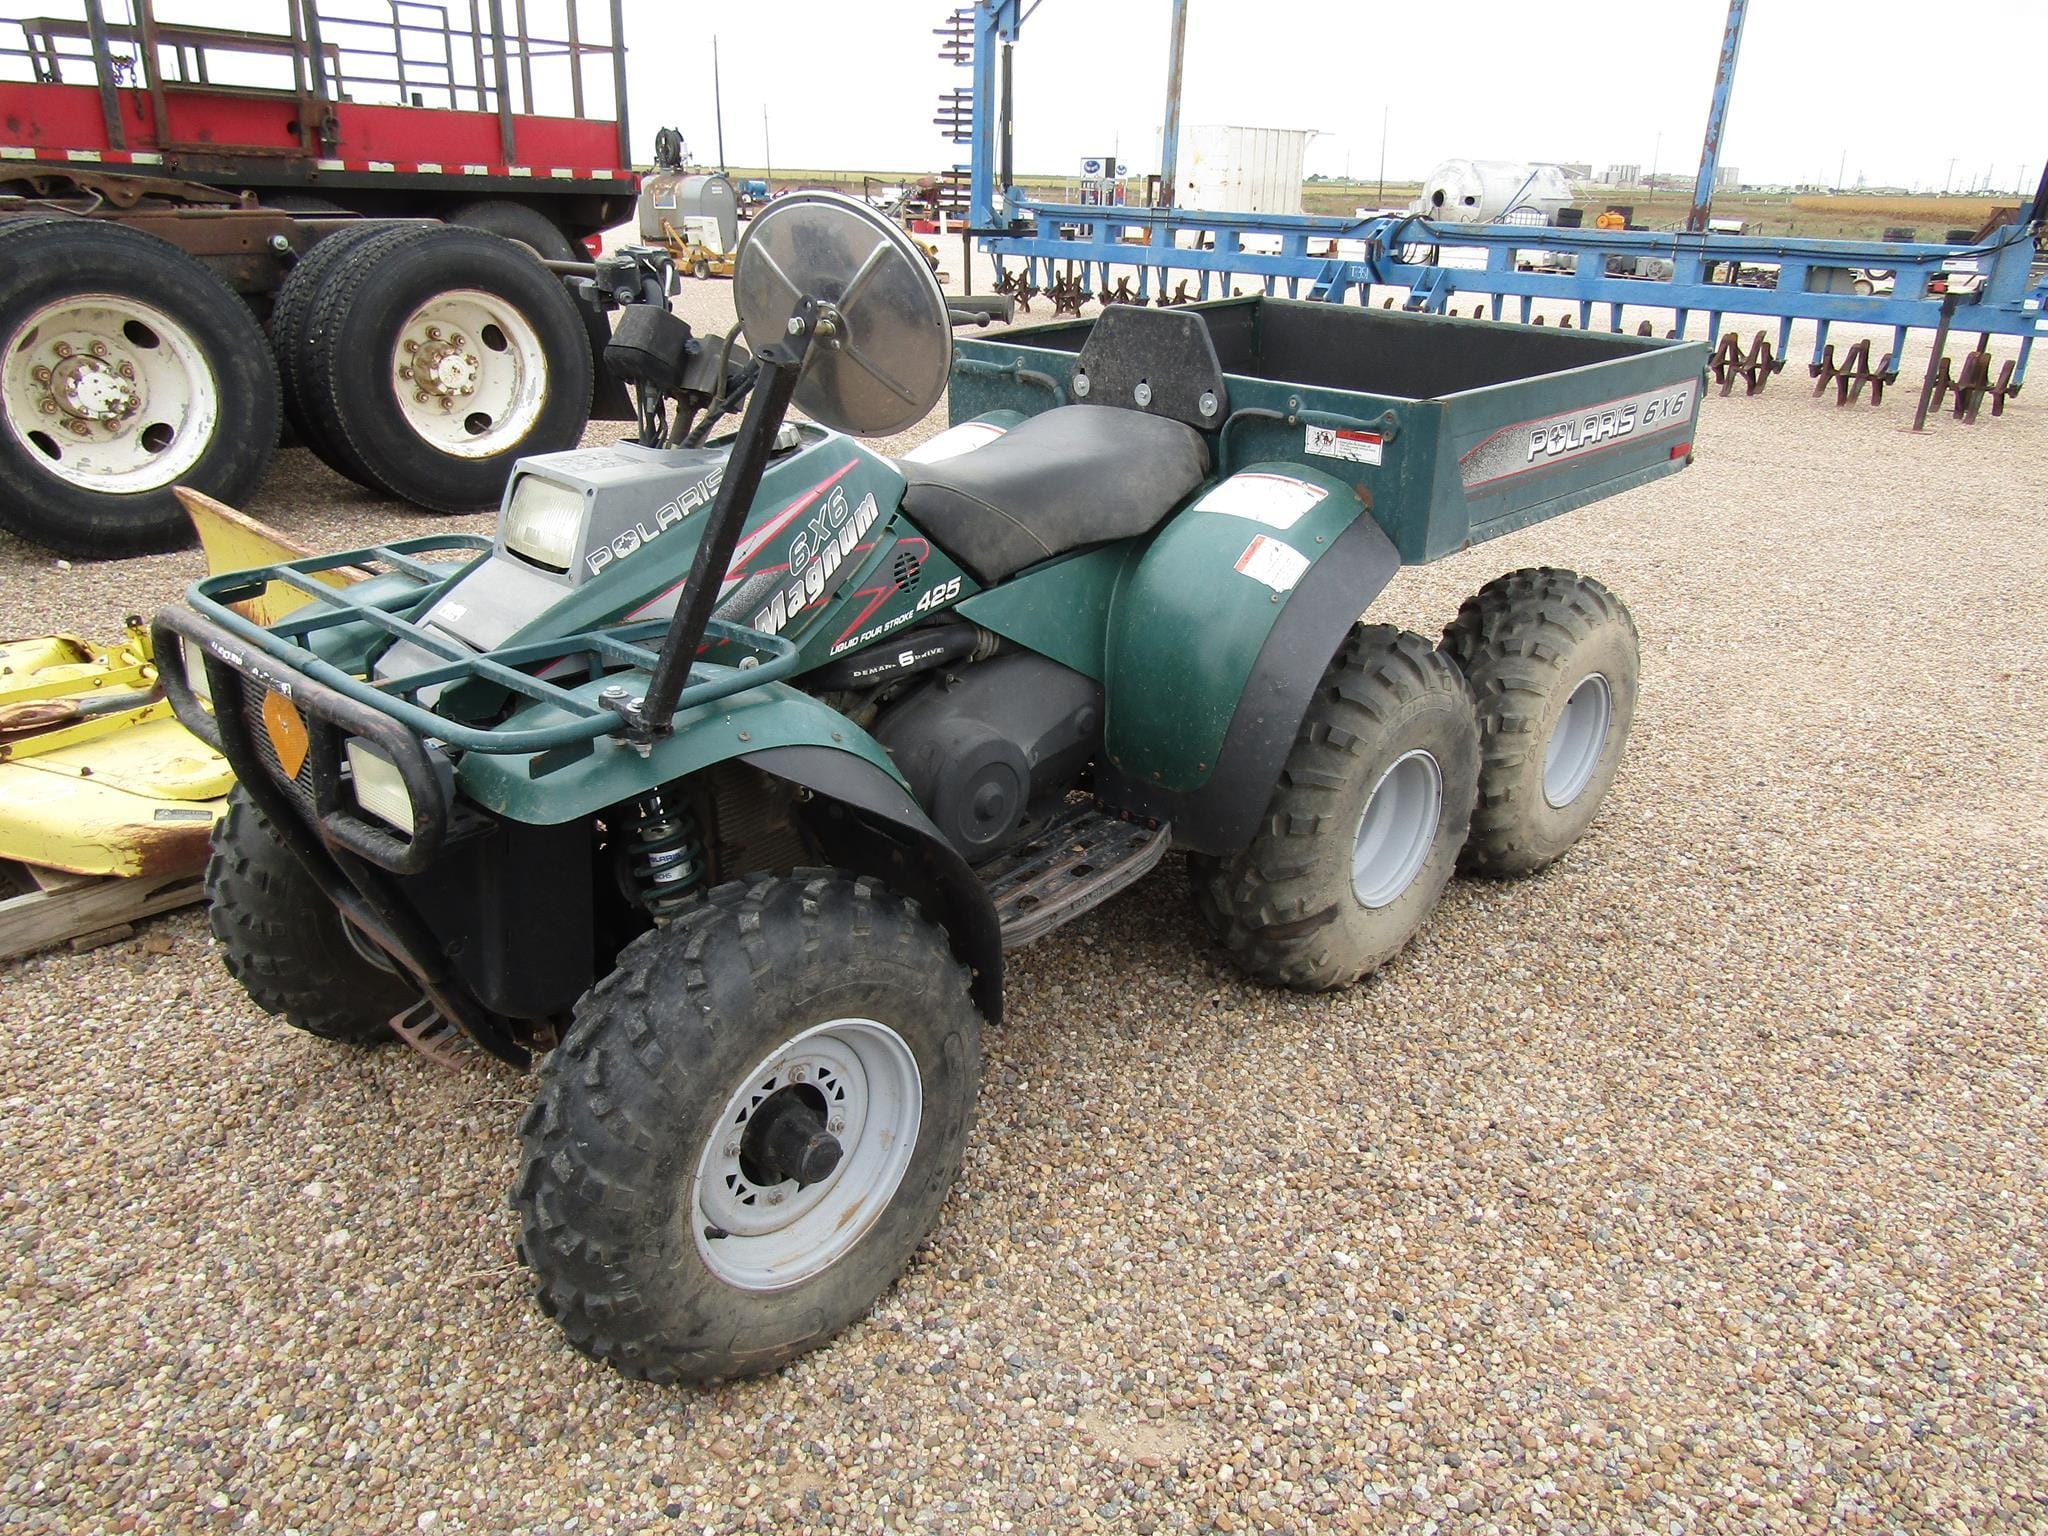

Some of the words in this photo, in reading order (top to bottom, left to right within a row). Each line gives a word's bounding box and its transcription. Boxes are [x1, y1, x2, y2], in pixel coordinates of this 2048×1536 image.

[1527, 403, 1638, 462] POLARIS
[1642, 390, 1688, 427] 6X6
[585, 467, 723, 576] POLARIS
[788, 485, 849, 577] 6X6
[754, 492, 880, 645] Magnum
[829, 636, 859, 656] LIQUID
[860, 625, 882, 644] FOUR
[883, 609, 914, 632] STROKE
[916, 575, 962, 613] 425
[898, 650, 915, 667] 6
